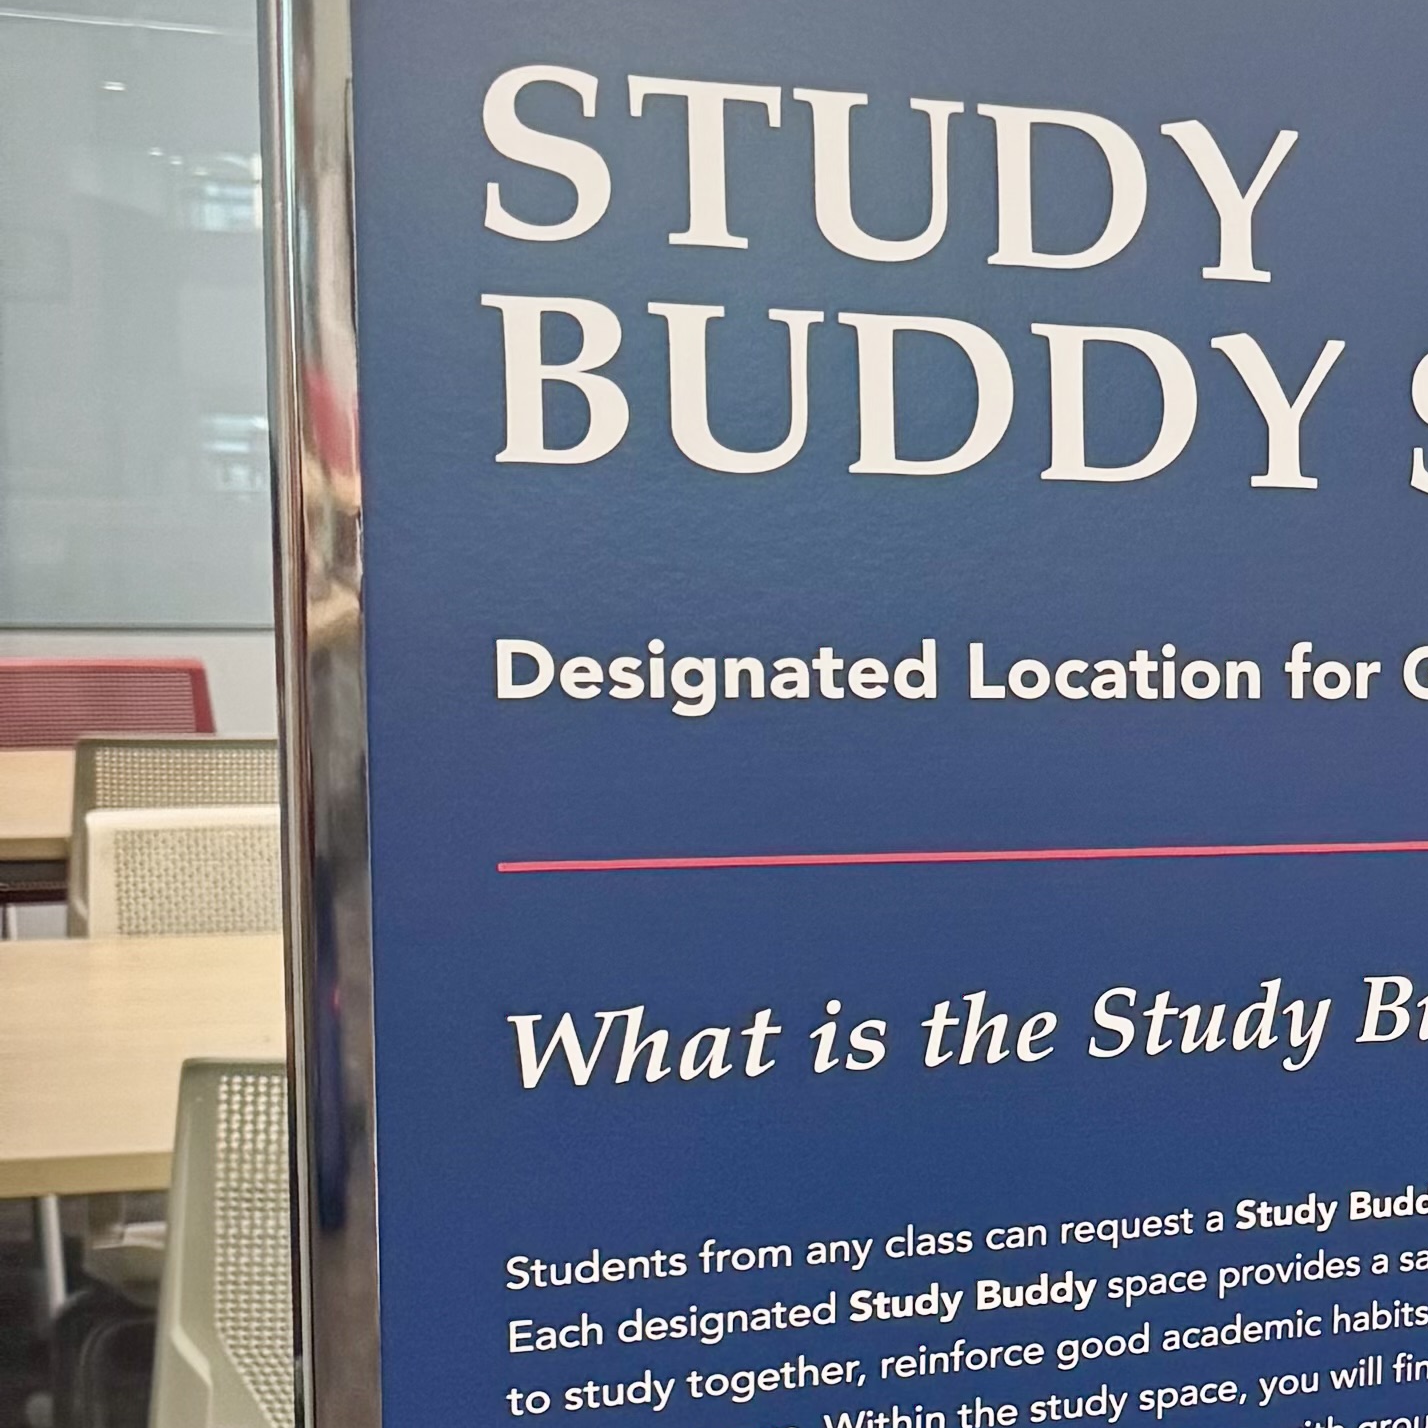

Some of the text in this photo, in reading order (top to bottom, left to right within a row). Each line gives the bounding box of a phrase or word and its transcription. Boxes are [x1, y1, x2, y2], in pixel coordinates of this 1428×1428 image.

[482, 64, 1299, 283] STUDY
[480, 293, 1346, 490] BUDDY
[495, 638, 937, 717] Designated
[969, 642, 1261, 700] Location
[1284, 641, 1382, 700] for
[506, 1005, 782, 1089] What
[809, 999, 887, 1074] is
[920, 990, 1058, 1068] the
[1088, 977, 1332, 1072] Study
[506, 1248, 688, 1290] Students
[698, 1238, 792, 1274] from
[806, 1238, 874, 1271] any
[885, 1223, 973, 1258] class
[985, 1224, 1047, 1250] can
[1061, 1208, 1194, 1249] request
[1205, 1210, 1224, 1233] a
[1235, 1192, 1338, 1232] Study
[509, 1312, 603, 1353] Each
[617, 1290, 836, 1345] designated
[849, 1282, 964, 1323] Study
[976, 1270, 1098, 1311] Buddy
[1107, 1270, 1208, 1308] space
[1219, 1248, 1361, 1299] provides
[1371, 1253, 1389, 1275] a
[505, 1388, 551, 1416] to
[564, 1369, 676, 1412] study
[685, 1354, 866, 1403] together,
[881, 1338, 1045, 1379] reinforce
[1056, 1321, 1150, 1371] good
[1162, 1309, 1322, 1351] academic
[1030, 1383, 1128, 1423] study
[1139, 1380, 1247, 1420] space,
[1258, 1372, 1319, 1407] you
[1330, 1355, 1382, 1390] will
